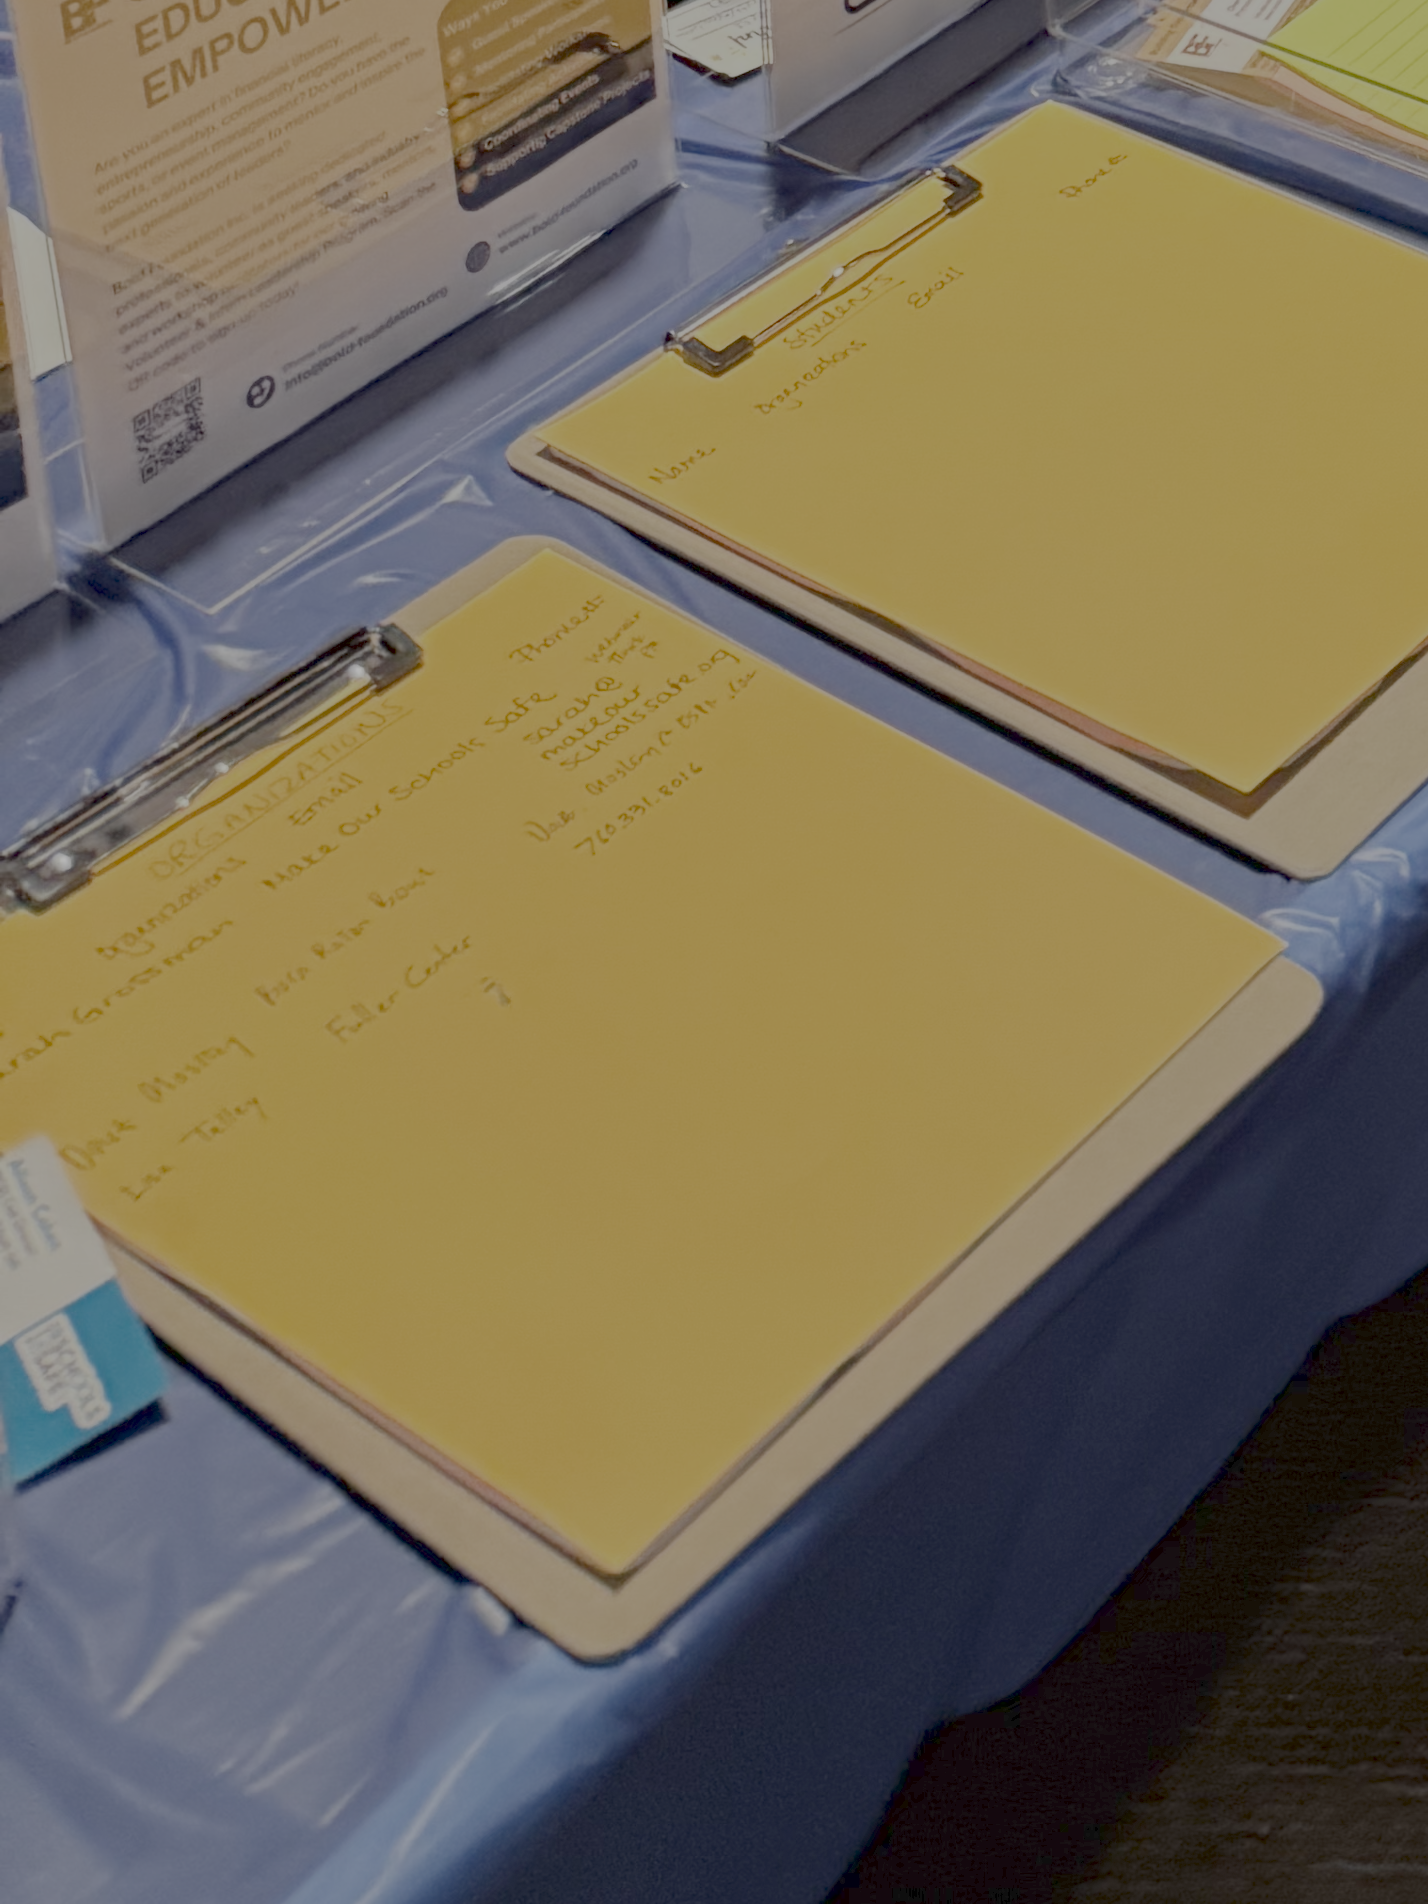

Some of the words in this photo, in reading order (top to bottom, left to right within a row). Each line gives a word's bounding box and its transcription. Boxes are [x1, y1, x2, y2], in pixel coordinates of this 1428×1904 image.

[559, 72, 601, 105] Events
[783, 270, 895, 353] Students
[648, 445, 717, 485] Name
[906, 266, 965, 310] Email
[522, 676, 624, 745] sarah@
[147, 698, 404, 880] ORGANIZATIONS
[286, 771, 364, 828] Email
[0, 1030, 72, 1082] arah
[71, 919, 236, 1026] Grossman
[260, 842, 340, 893] Make
[338, 803, 383, 838] Our
[387, 736, 487, 804] Schools
[484, 691, 559, 734] Safe
[402, 934, 473, 990] Center
